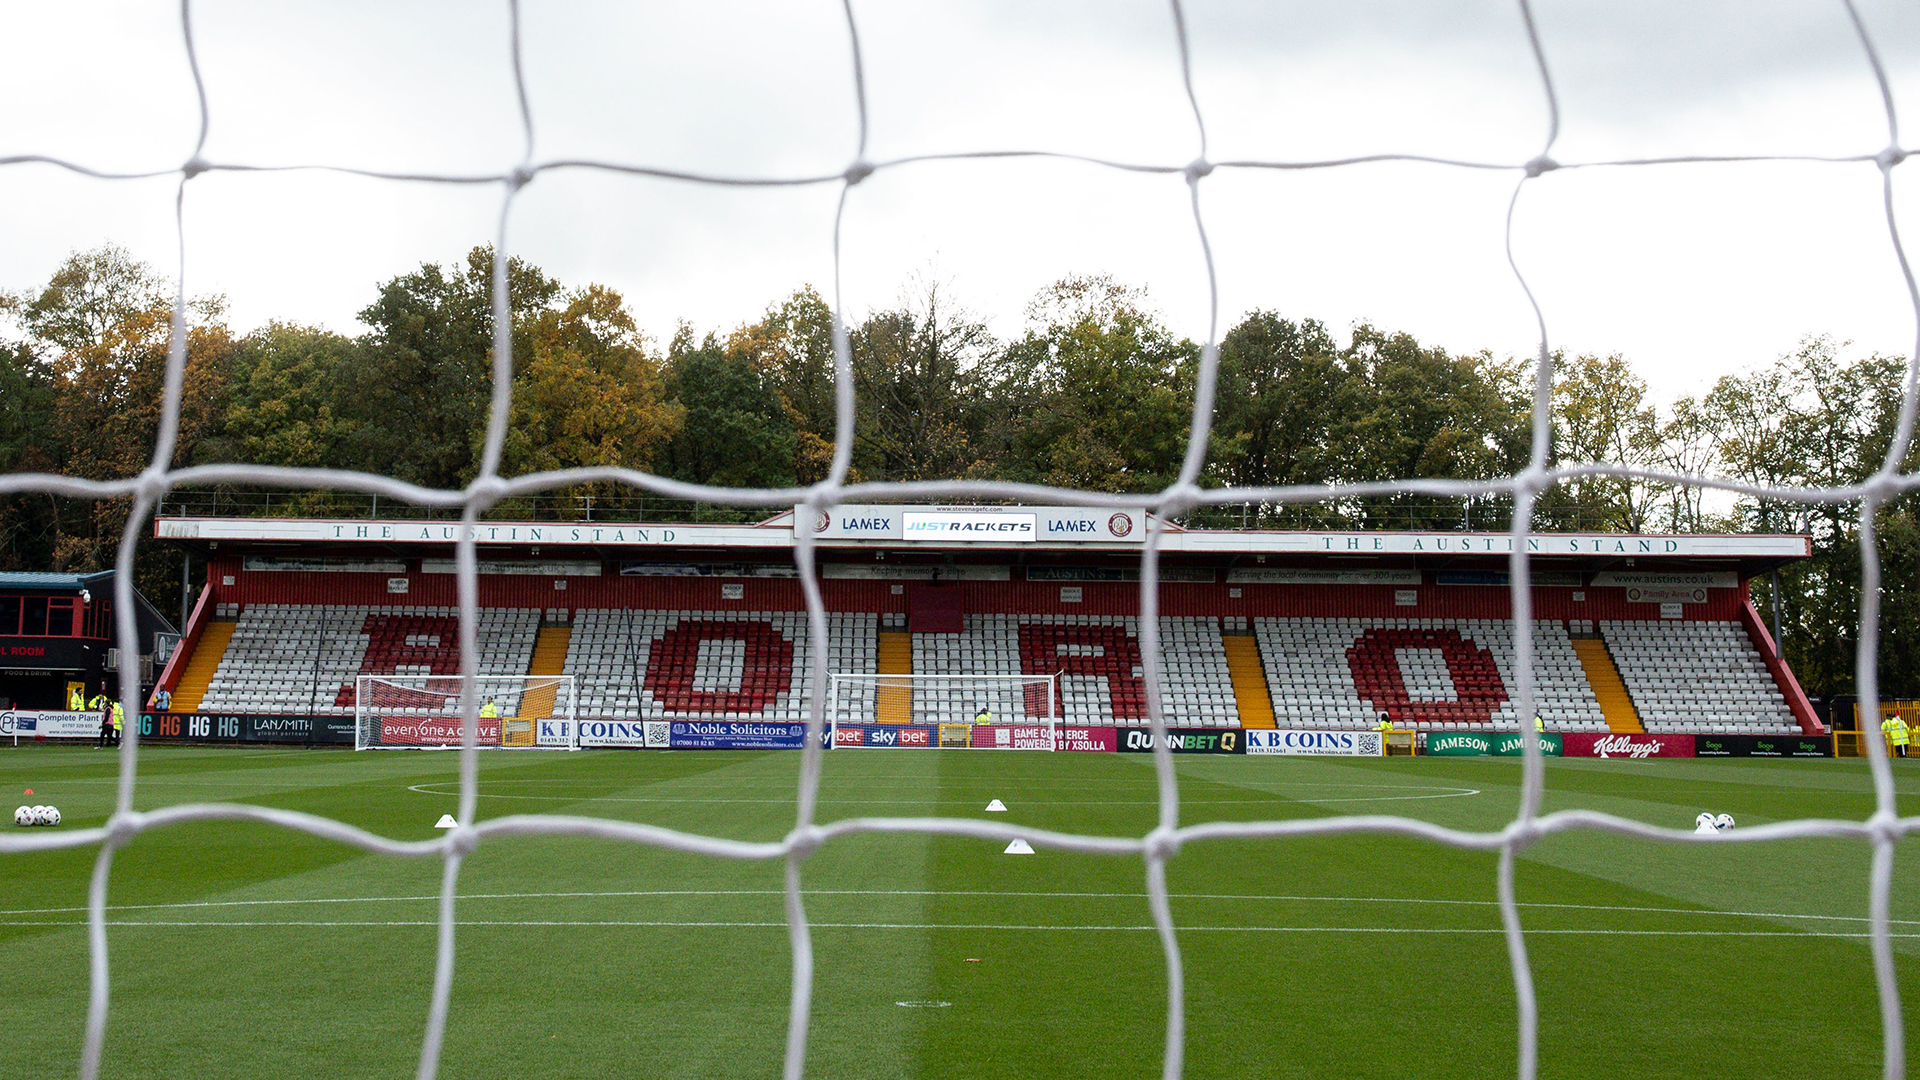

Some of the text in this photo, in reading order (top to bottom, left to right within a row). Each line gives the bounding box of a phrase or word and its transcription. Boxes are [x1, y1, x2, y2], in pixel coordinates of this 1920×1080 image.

[842, 518, 891, 530] LAMEX
[906, 521, 1032, 532] JUSTRACKETS
[1048, 520, 1096, 532] LAMEX
[333, 526, 391, 538] THE
[571, 528, 675, 542] STAND
[1322, 537, 1678, 552] THE AUSTIN STAND
[1234, 569, 1261, 580] Serving
[1264, 570, 1277, 578] the
[1279, 570, 1295, 578] local
[1298, 571, 1339, 580] community
[1374, 571, 1389, 580] 300
[1391, 573, 1412, 581] years
[1614, 573, 1714, 584] www.austins.co.uk
[1643, 590, 1690, 599] Family Area
[11, 647, 45, 657] ROOM
[38, 714, 76, 724] Complete
[78, 714, 100, 723] Plant
[254, 719, 313, 731] LANSMITH
[160, 716, 181, 736] HG
[189, 716, 210, 737] HG
[218, 717, 239, 737] HG
[384, 722, 496, 737] everyone ACIVE
[541, 722, 556, 737] K
[580, 722, 643, 738] COINS
[688, 723, 787, 735] Noble Solicitors
[836, 730, 861, 742] bet
[871, 729, 897, 746] sky
[901, 730, 926, 743] bet
[1014, 728, 1038, 739] GAME
[1058, 740, 1069, 750] BY
[1072, 740, 1106, 751] XSOLLA
[1247, 732, 1353, 749] K B COINS
[1434, 737, 1555, 753] JAMESON JAMON
[1593, 734, 1661, 758] Kellogg's
